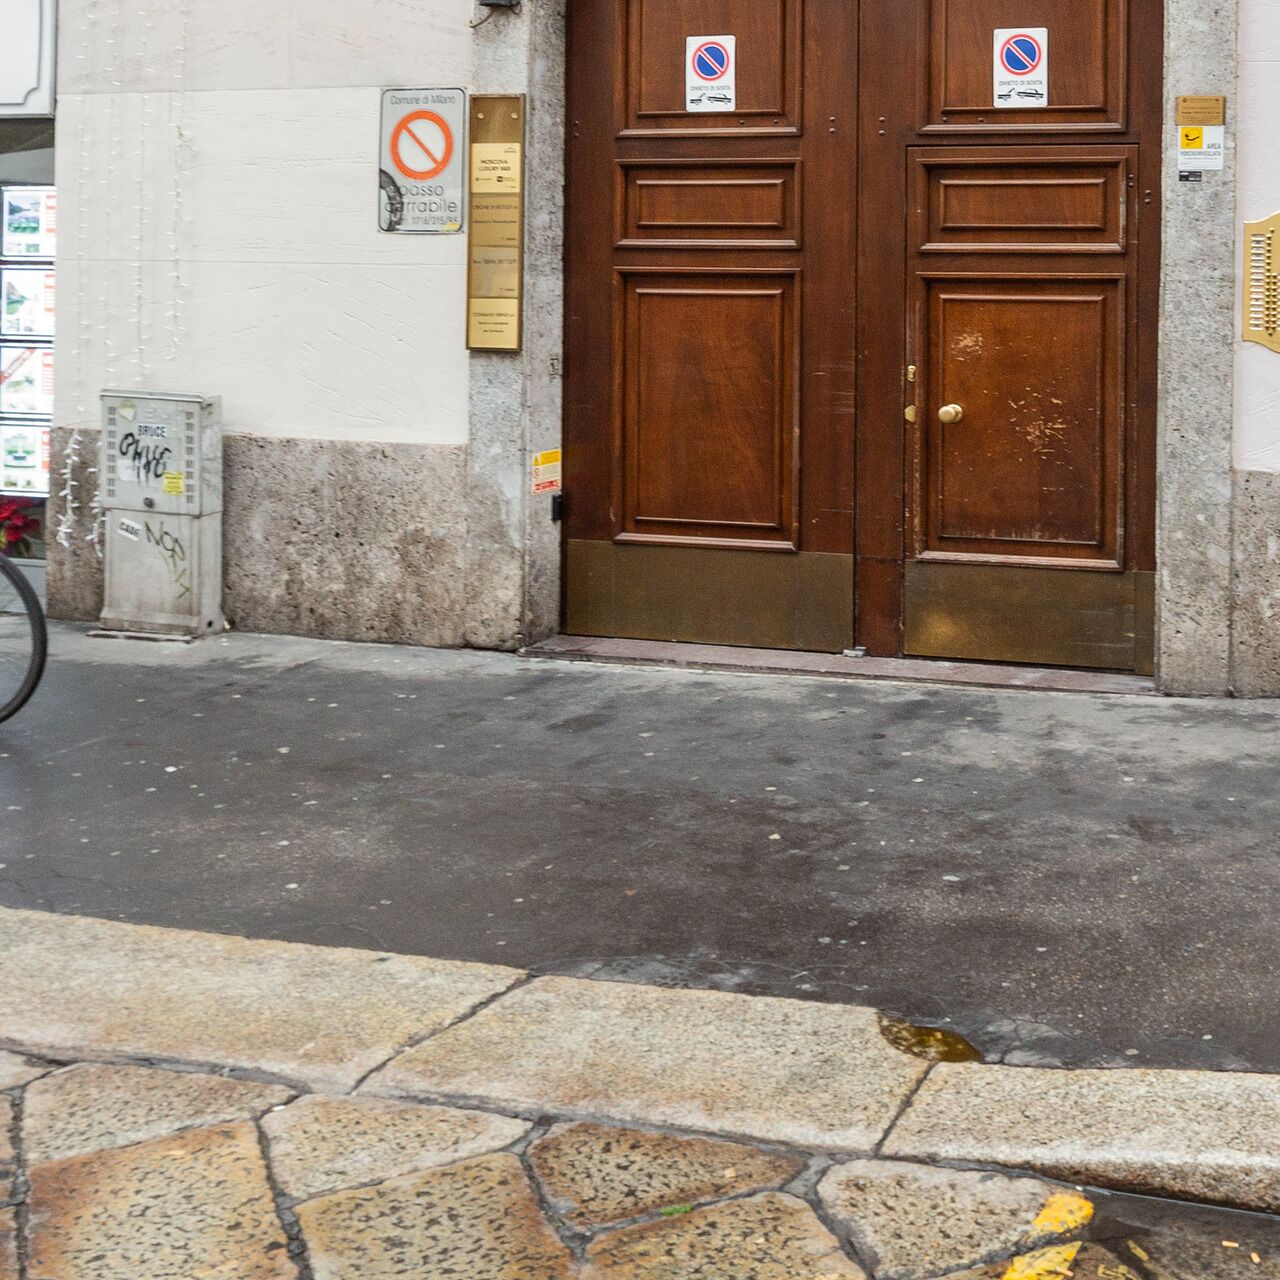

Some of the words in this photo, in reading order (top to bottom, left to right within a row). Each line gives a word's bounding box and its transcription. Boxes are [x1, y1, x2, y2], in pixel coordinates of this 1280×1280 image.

[390, 95, 421, 105] Comune
[422, 95, 429, 104] di
[431, 94, 457, 104] Milano
[137, 424, 166, 439] BRUCE
